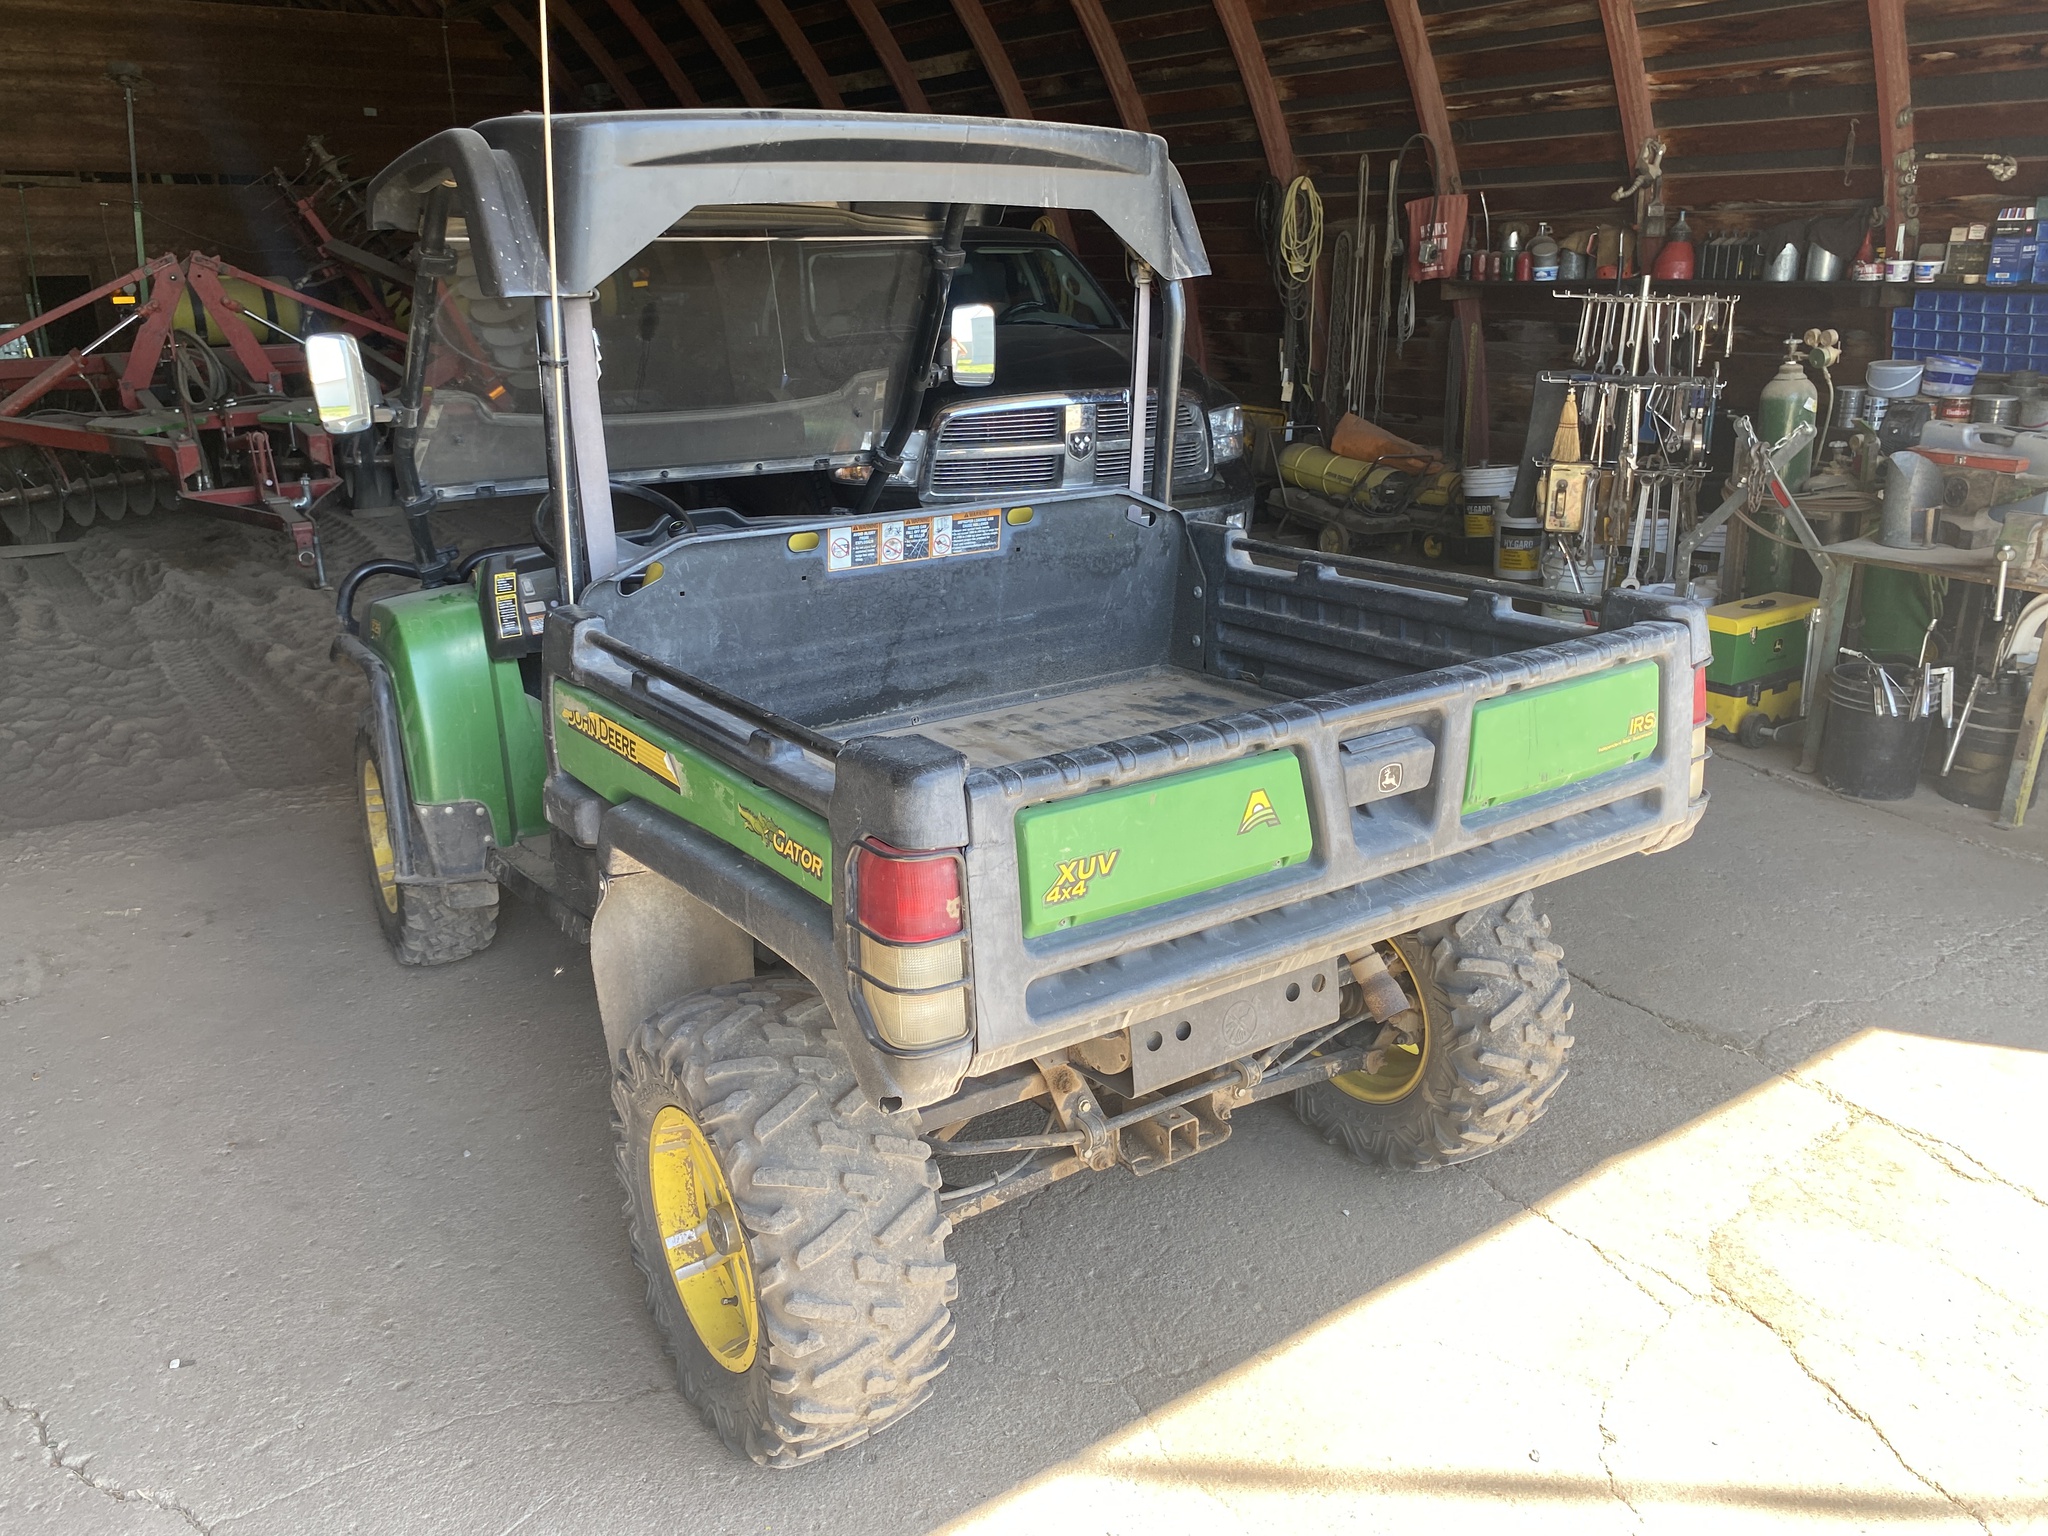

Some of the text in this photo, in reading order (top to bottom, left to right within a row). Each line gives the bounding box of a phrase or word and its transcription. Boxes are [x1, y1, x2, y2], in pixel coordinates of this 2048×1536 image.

[1503, 539, 1534, 549] HY-GARD
[568, 710, 638, 761] JOHN DEERE
[1629, 711, 1655, 736] IRS
[773, 829, 823, 880] GATOR
[1056, 850, 1120, 886] XUV
[1045, 880, 1088, 903] 4x4
